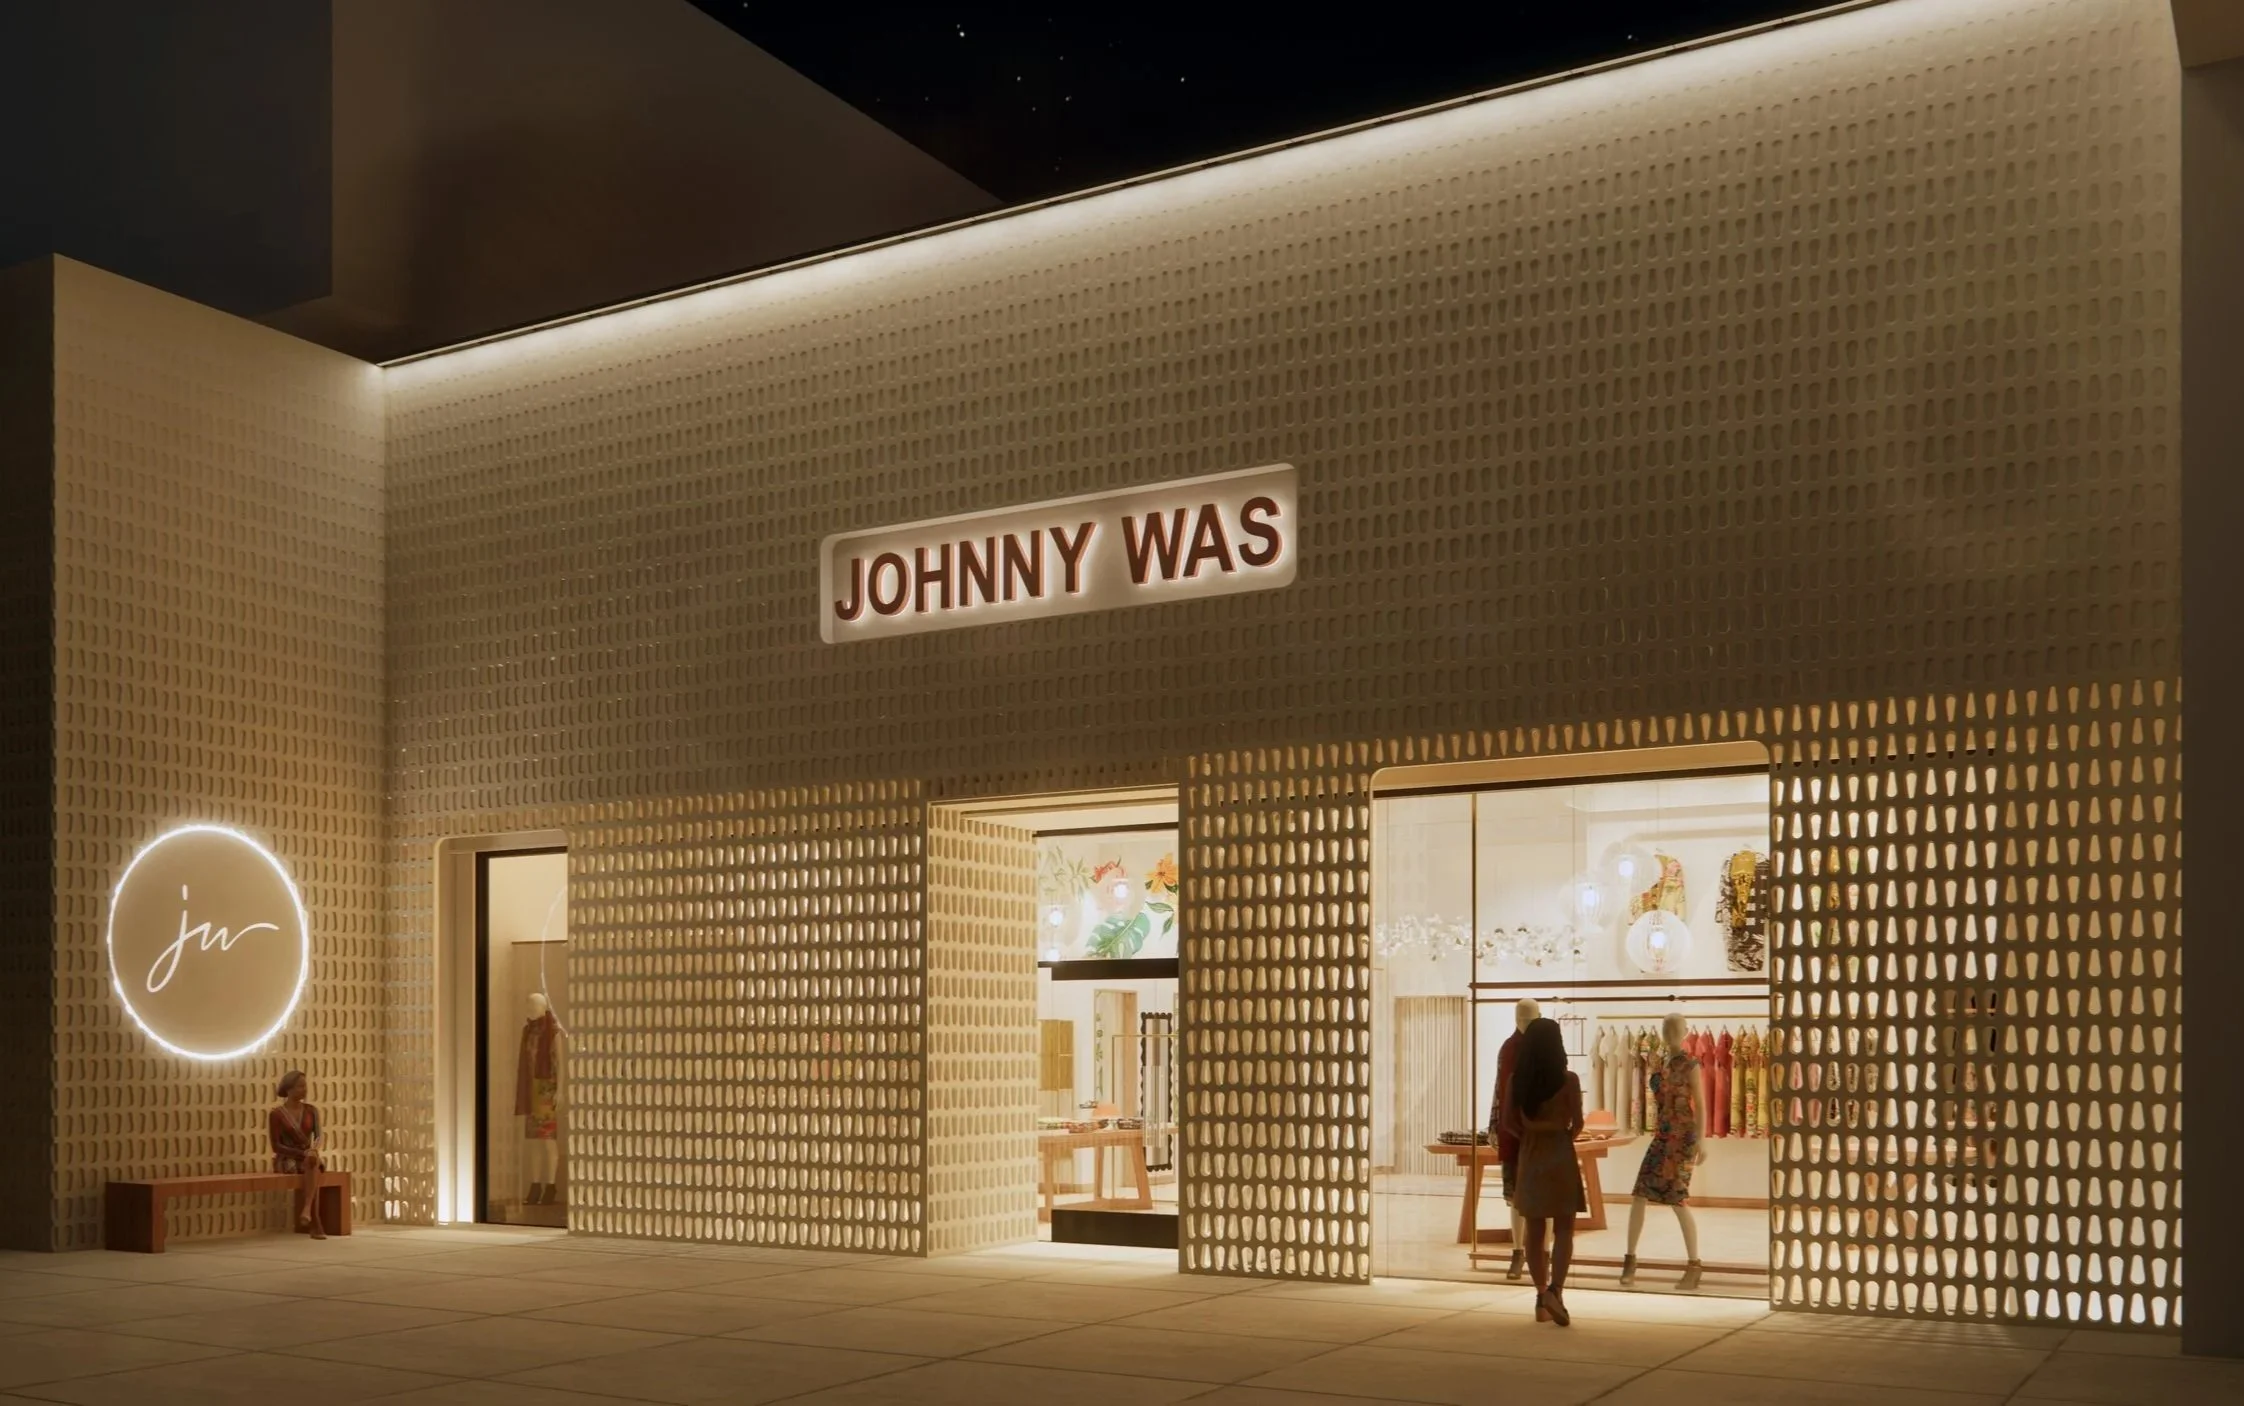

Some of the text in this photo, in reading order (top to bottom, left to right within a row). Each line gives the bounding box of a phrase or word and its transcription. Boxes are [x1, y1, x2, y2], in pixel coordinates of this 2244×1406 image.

[834, 496, 1283, 622] JOHNNY WAS
[146, 884, 279, 993] jw
